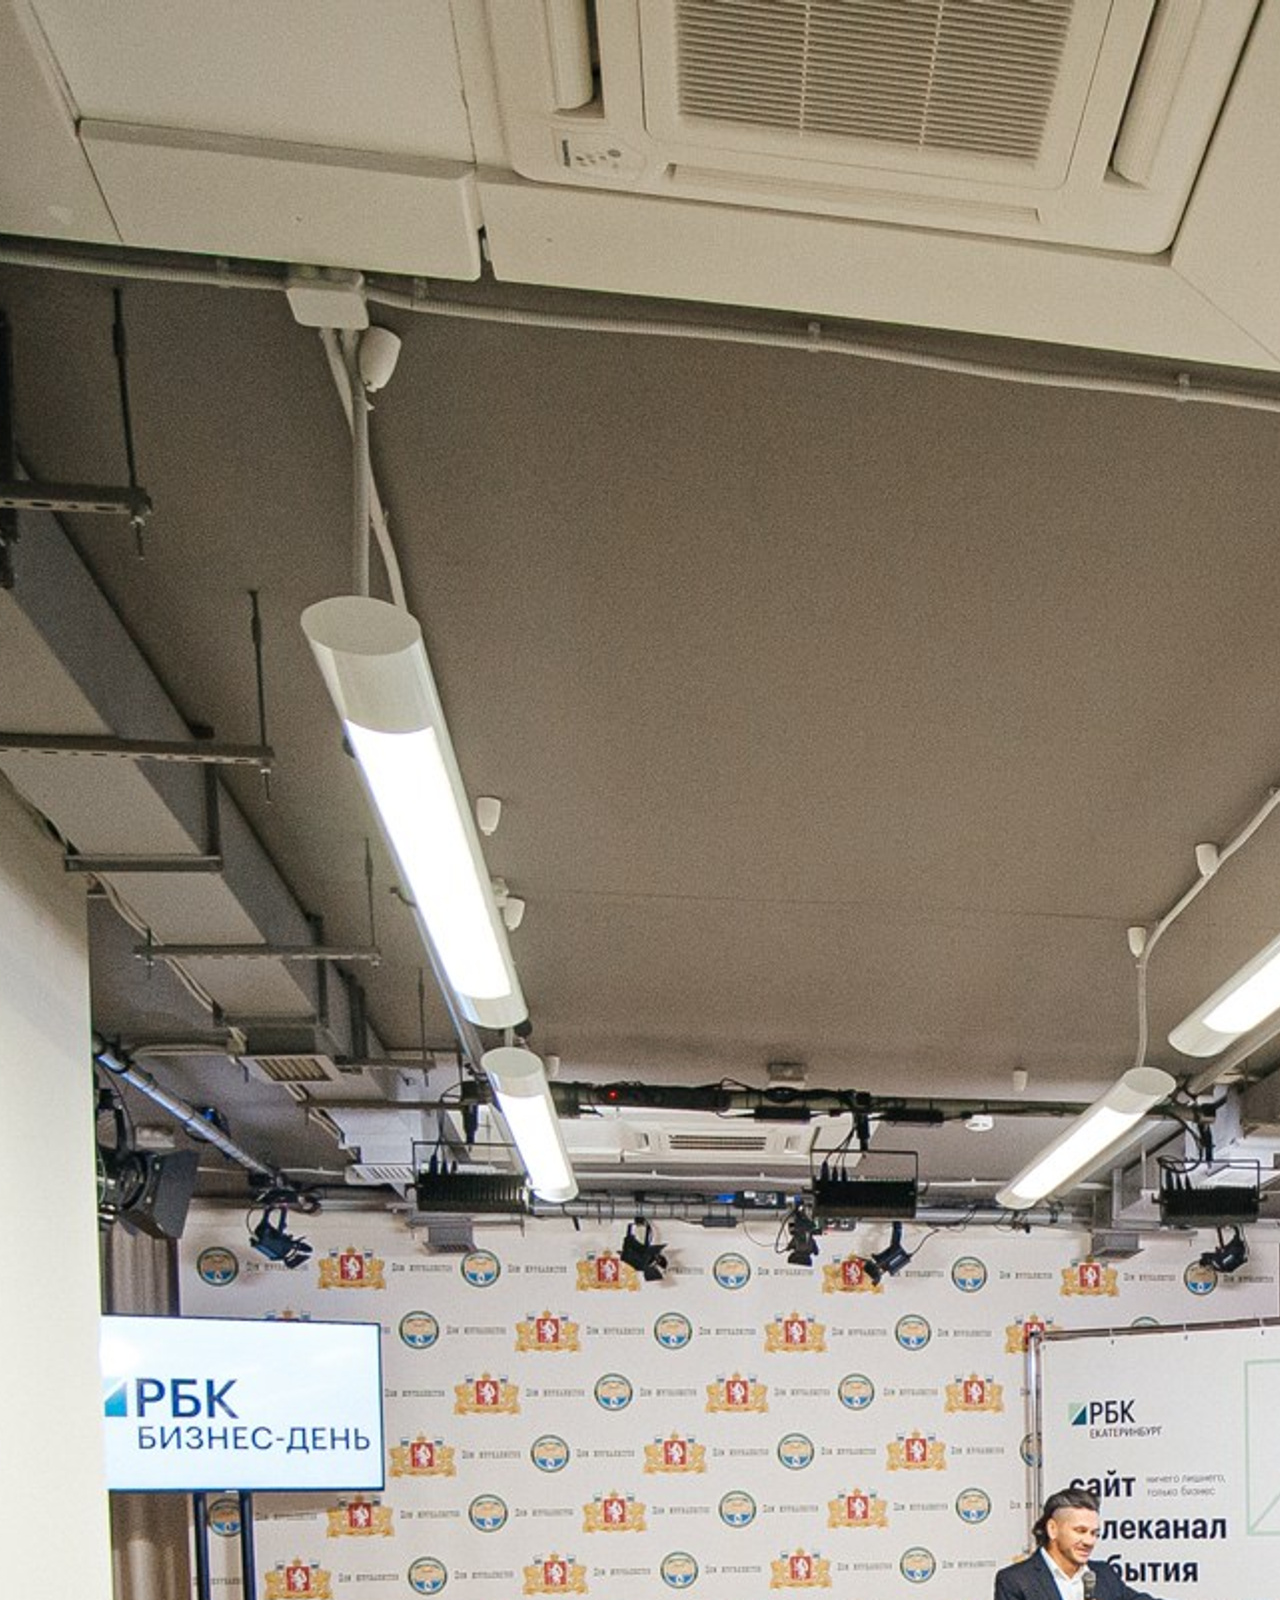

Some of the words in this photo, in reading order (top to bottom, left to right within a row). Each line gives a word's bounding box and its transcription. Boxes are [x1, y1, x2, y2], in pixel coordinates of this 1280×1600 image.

[135, 1378, 239, 1419] РБК
[1090, 1399, 1136, 1425] РБК
[138, 1426, 371, 1453] БИЗНЕС-ДЕНЬ
[1090, 1426, 1162, 1439] ЕКАТЕРИНБУРГ
[1181, 1485, 1216, 1497] бизнес
[1097, 1518, 1227, 1540] леканал
[1107, 1554, 1198, 1582] бытия
